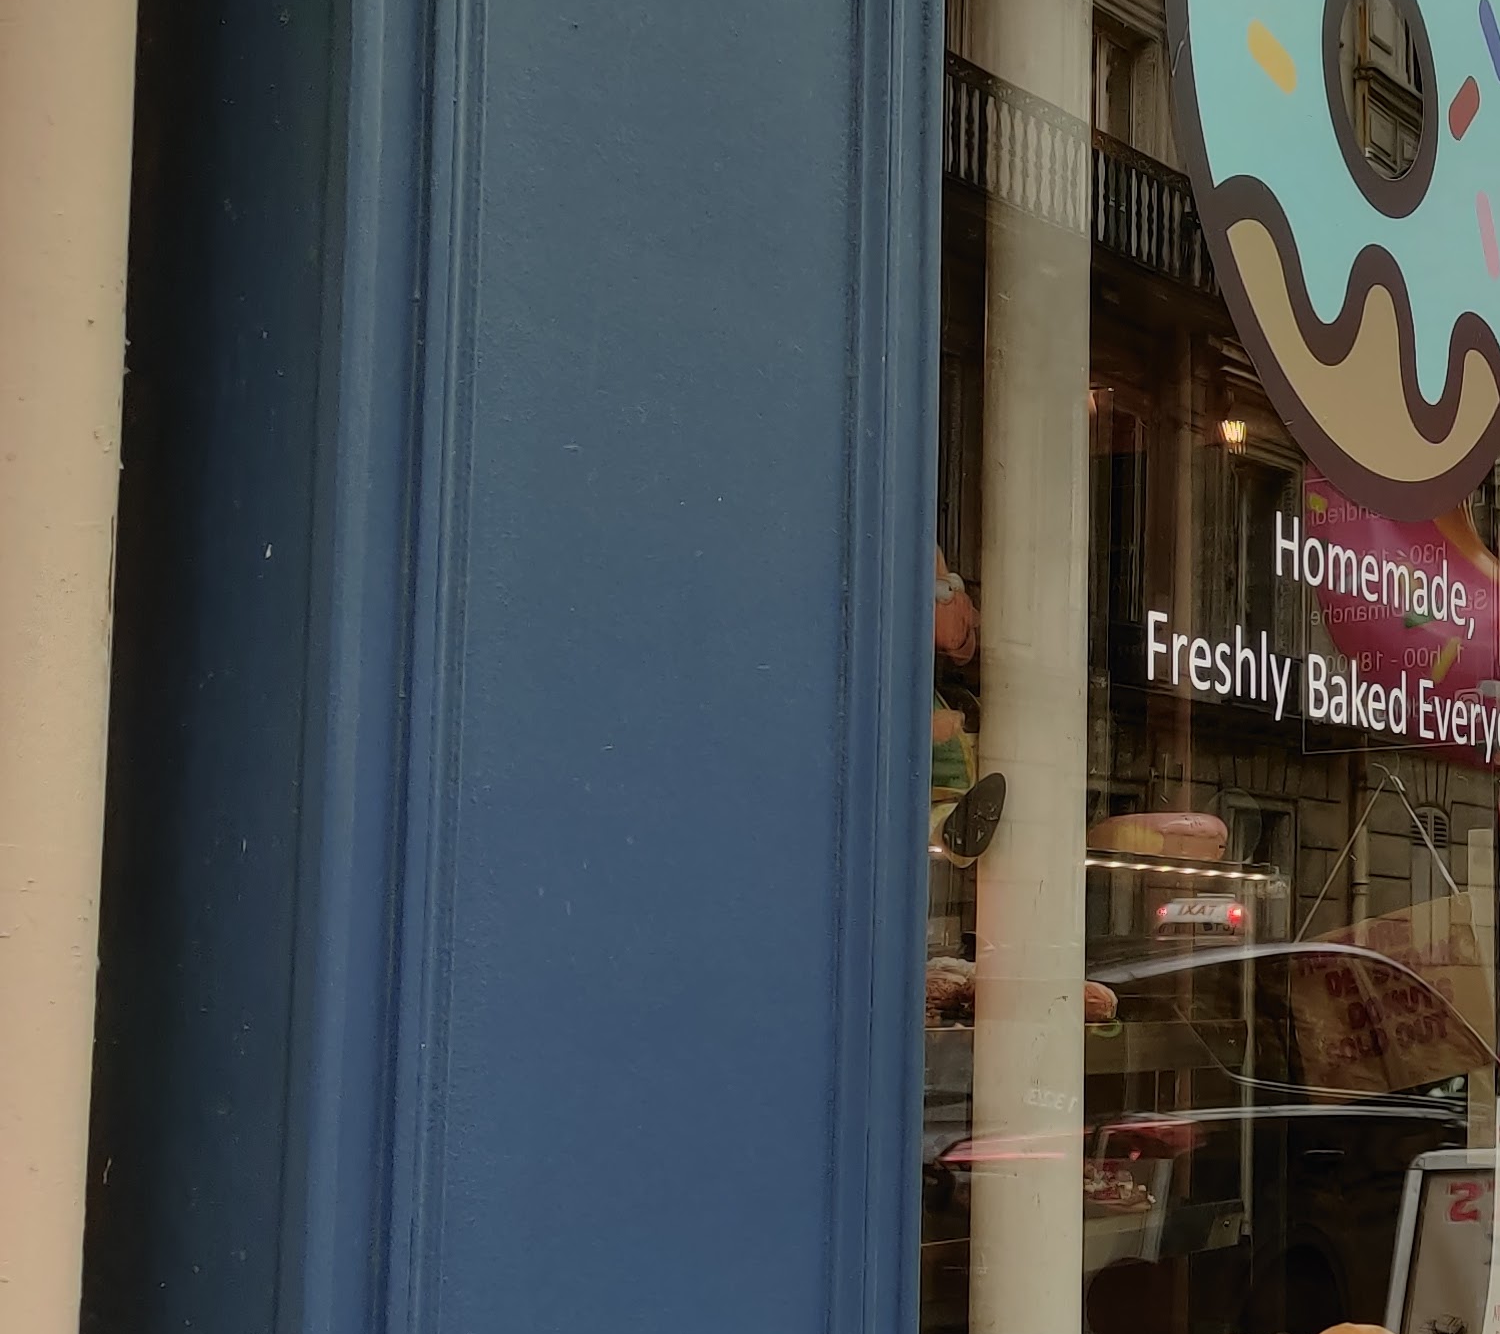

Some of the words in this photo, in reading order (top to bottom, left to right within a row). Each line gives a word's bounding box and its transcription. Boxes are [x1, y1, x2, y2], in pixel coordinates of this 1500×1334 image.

[1274, 511, 1477, 640] Homemade,
[1146, 610, 1292, 721] Freshly
[1307, 653, 1407, 736] Baked
